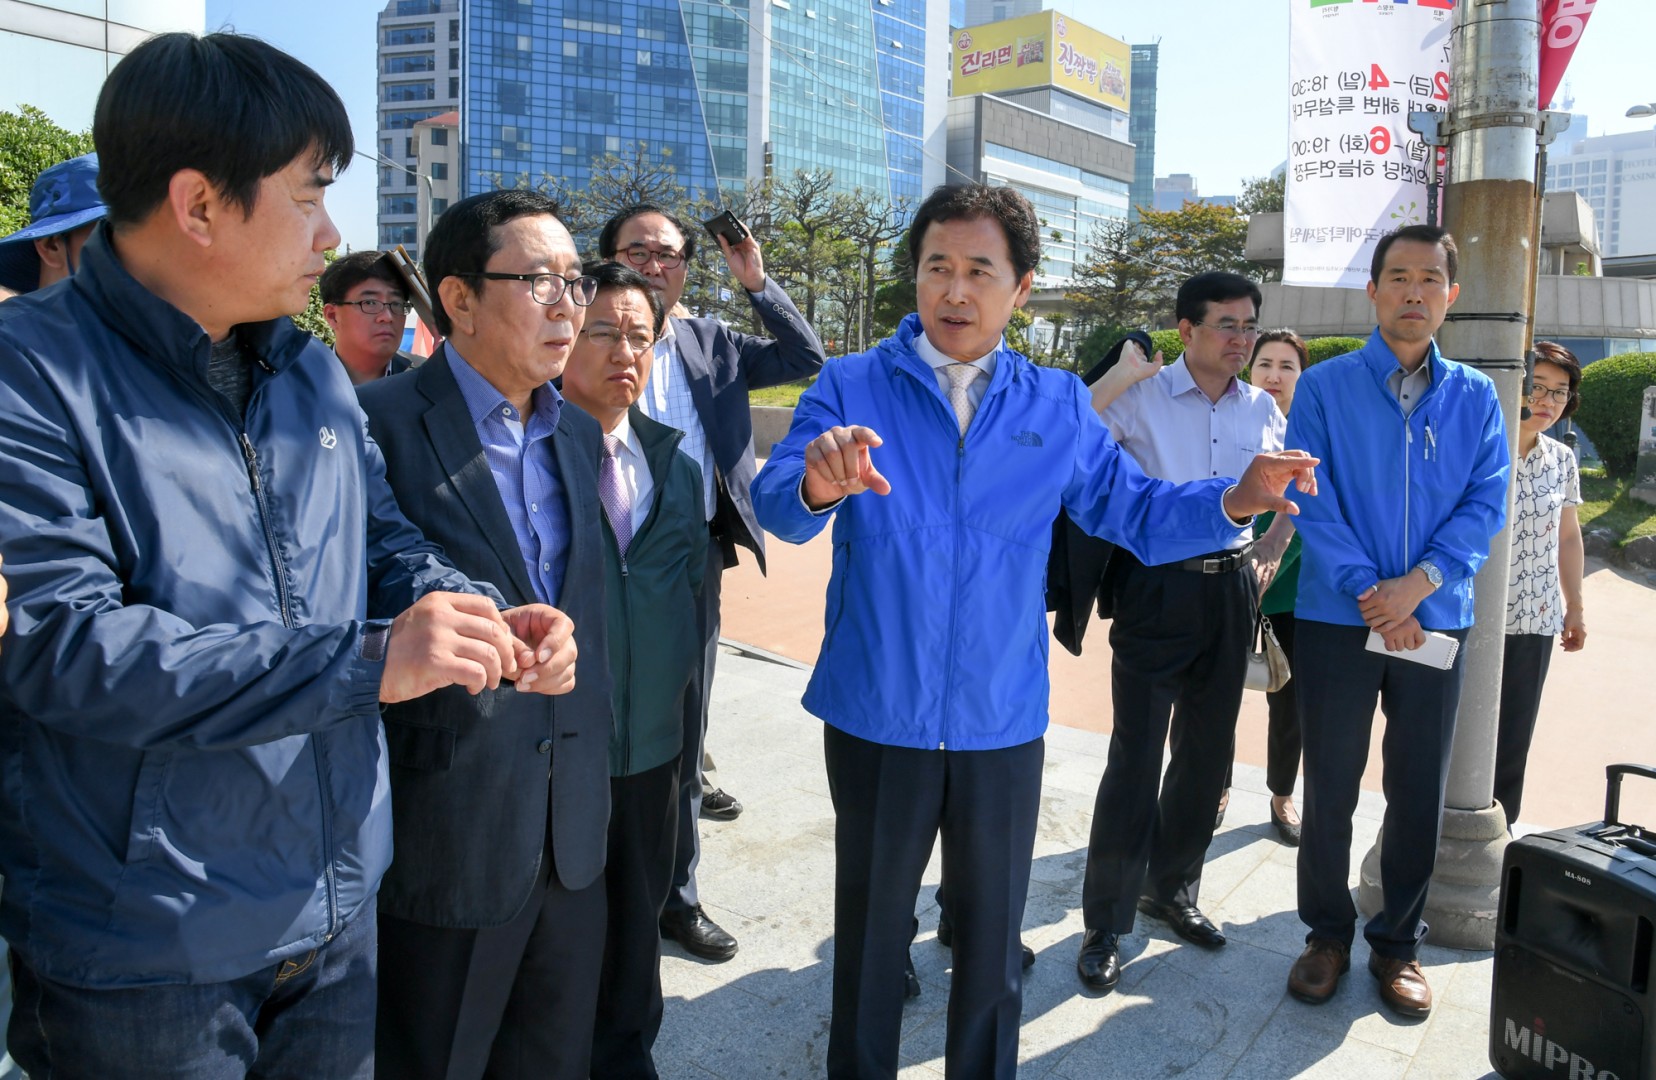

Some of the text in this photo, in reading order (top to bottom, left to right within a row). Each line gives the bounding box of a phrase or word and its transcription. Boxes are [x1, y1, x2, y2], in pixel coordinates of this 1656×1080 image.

[960, 44, 1013, 76] 진라면
[1057, 42, 1097, 83] 진짬뽕
[1623, 158, 1656, 169] HOTE
